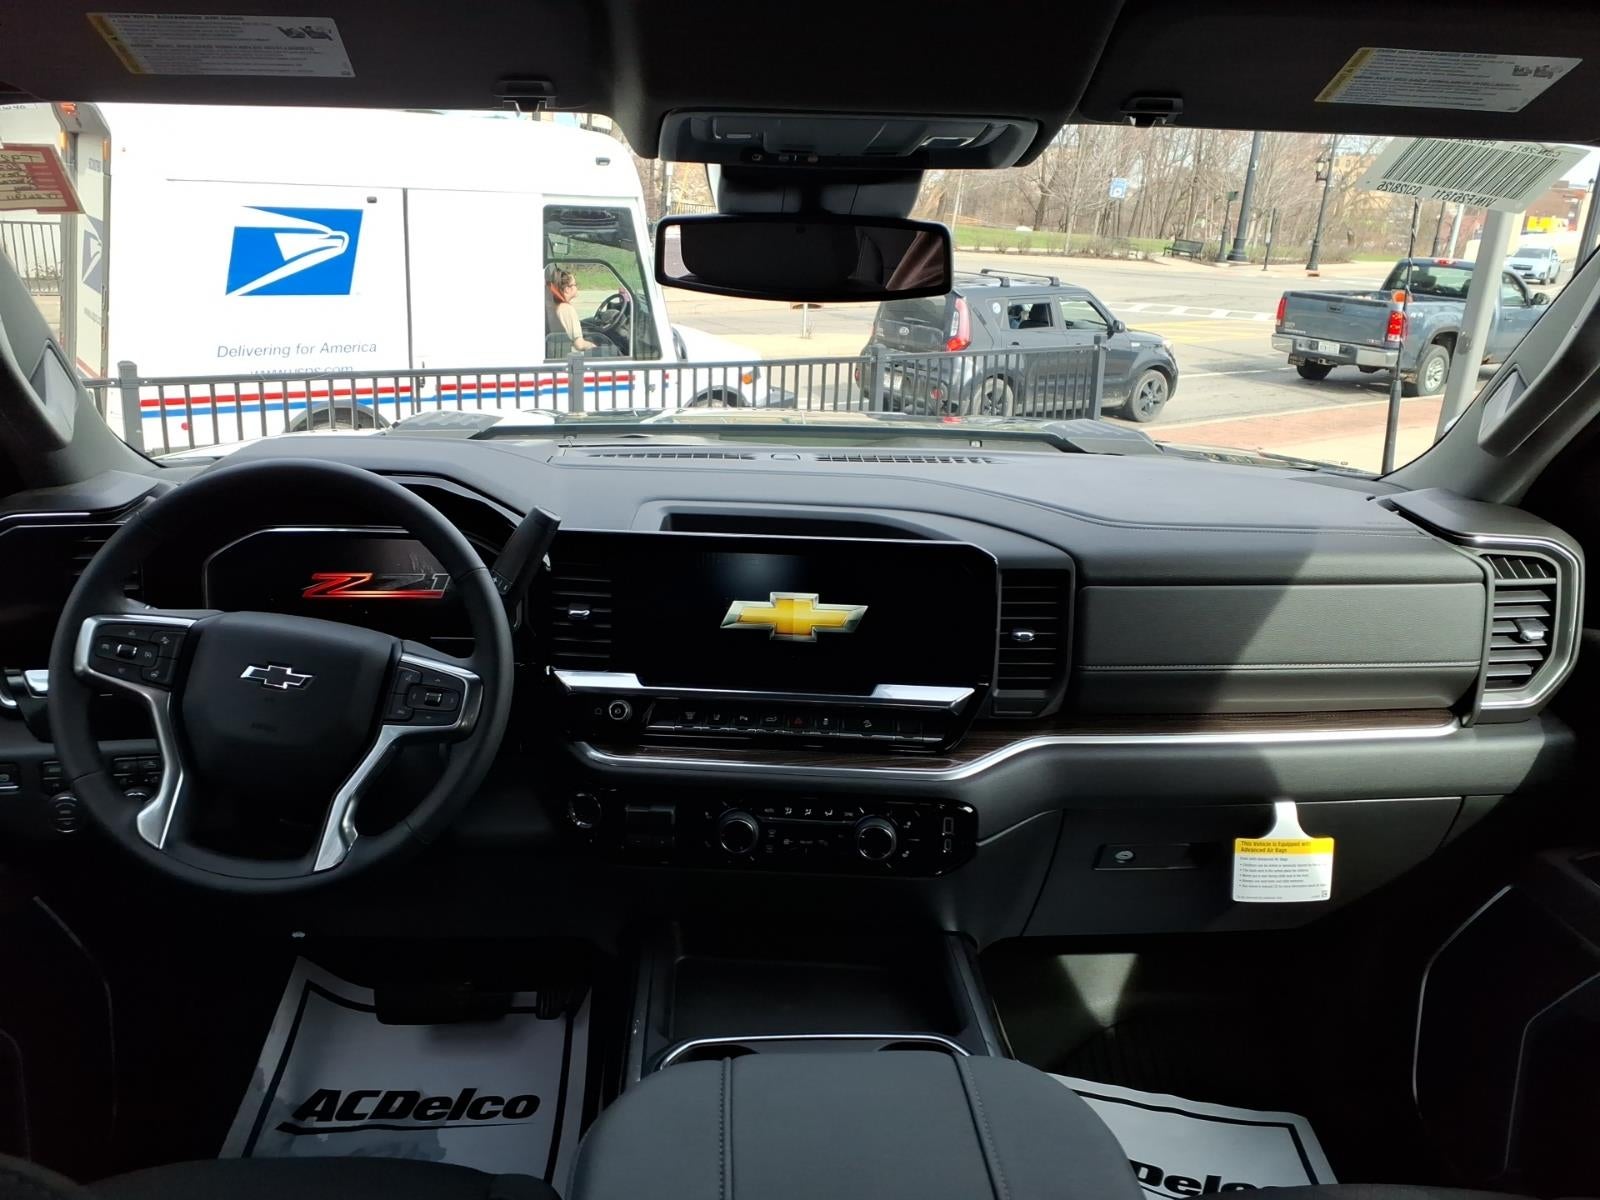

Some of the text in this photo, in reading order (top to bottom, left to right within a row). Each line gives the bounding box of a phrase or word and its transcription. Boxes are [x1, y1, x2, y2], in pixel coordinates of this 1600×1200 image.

[217, 342, 377, 358] Delivering for America
[292, 1087, 542, 1122] ACDelco
